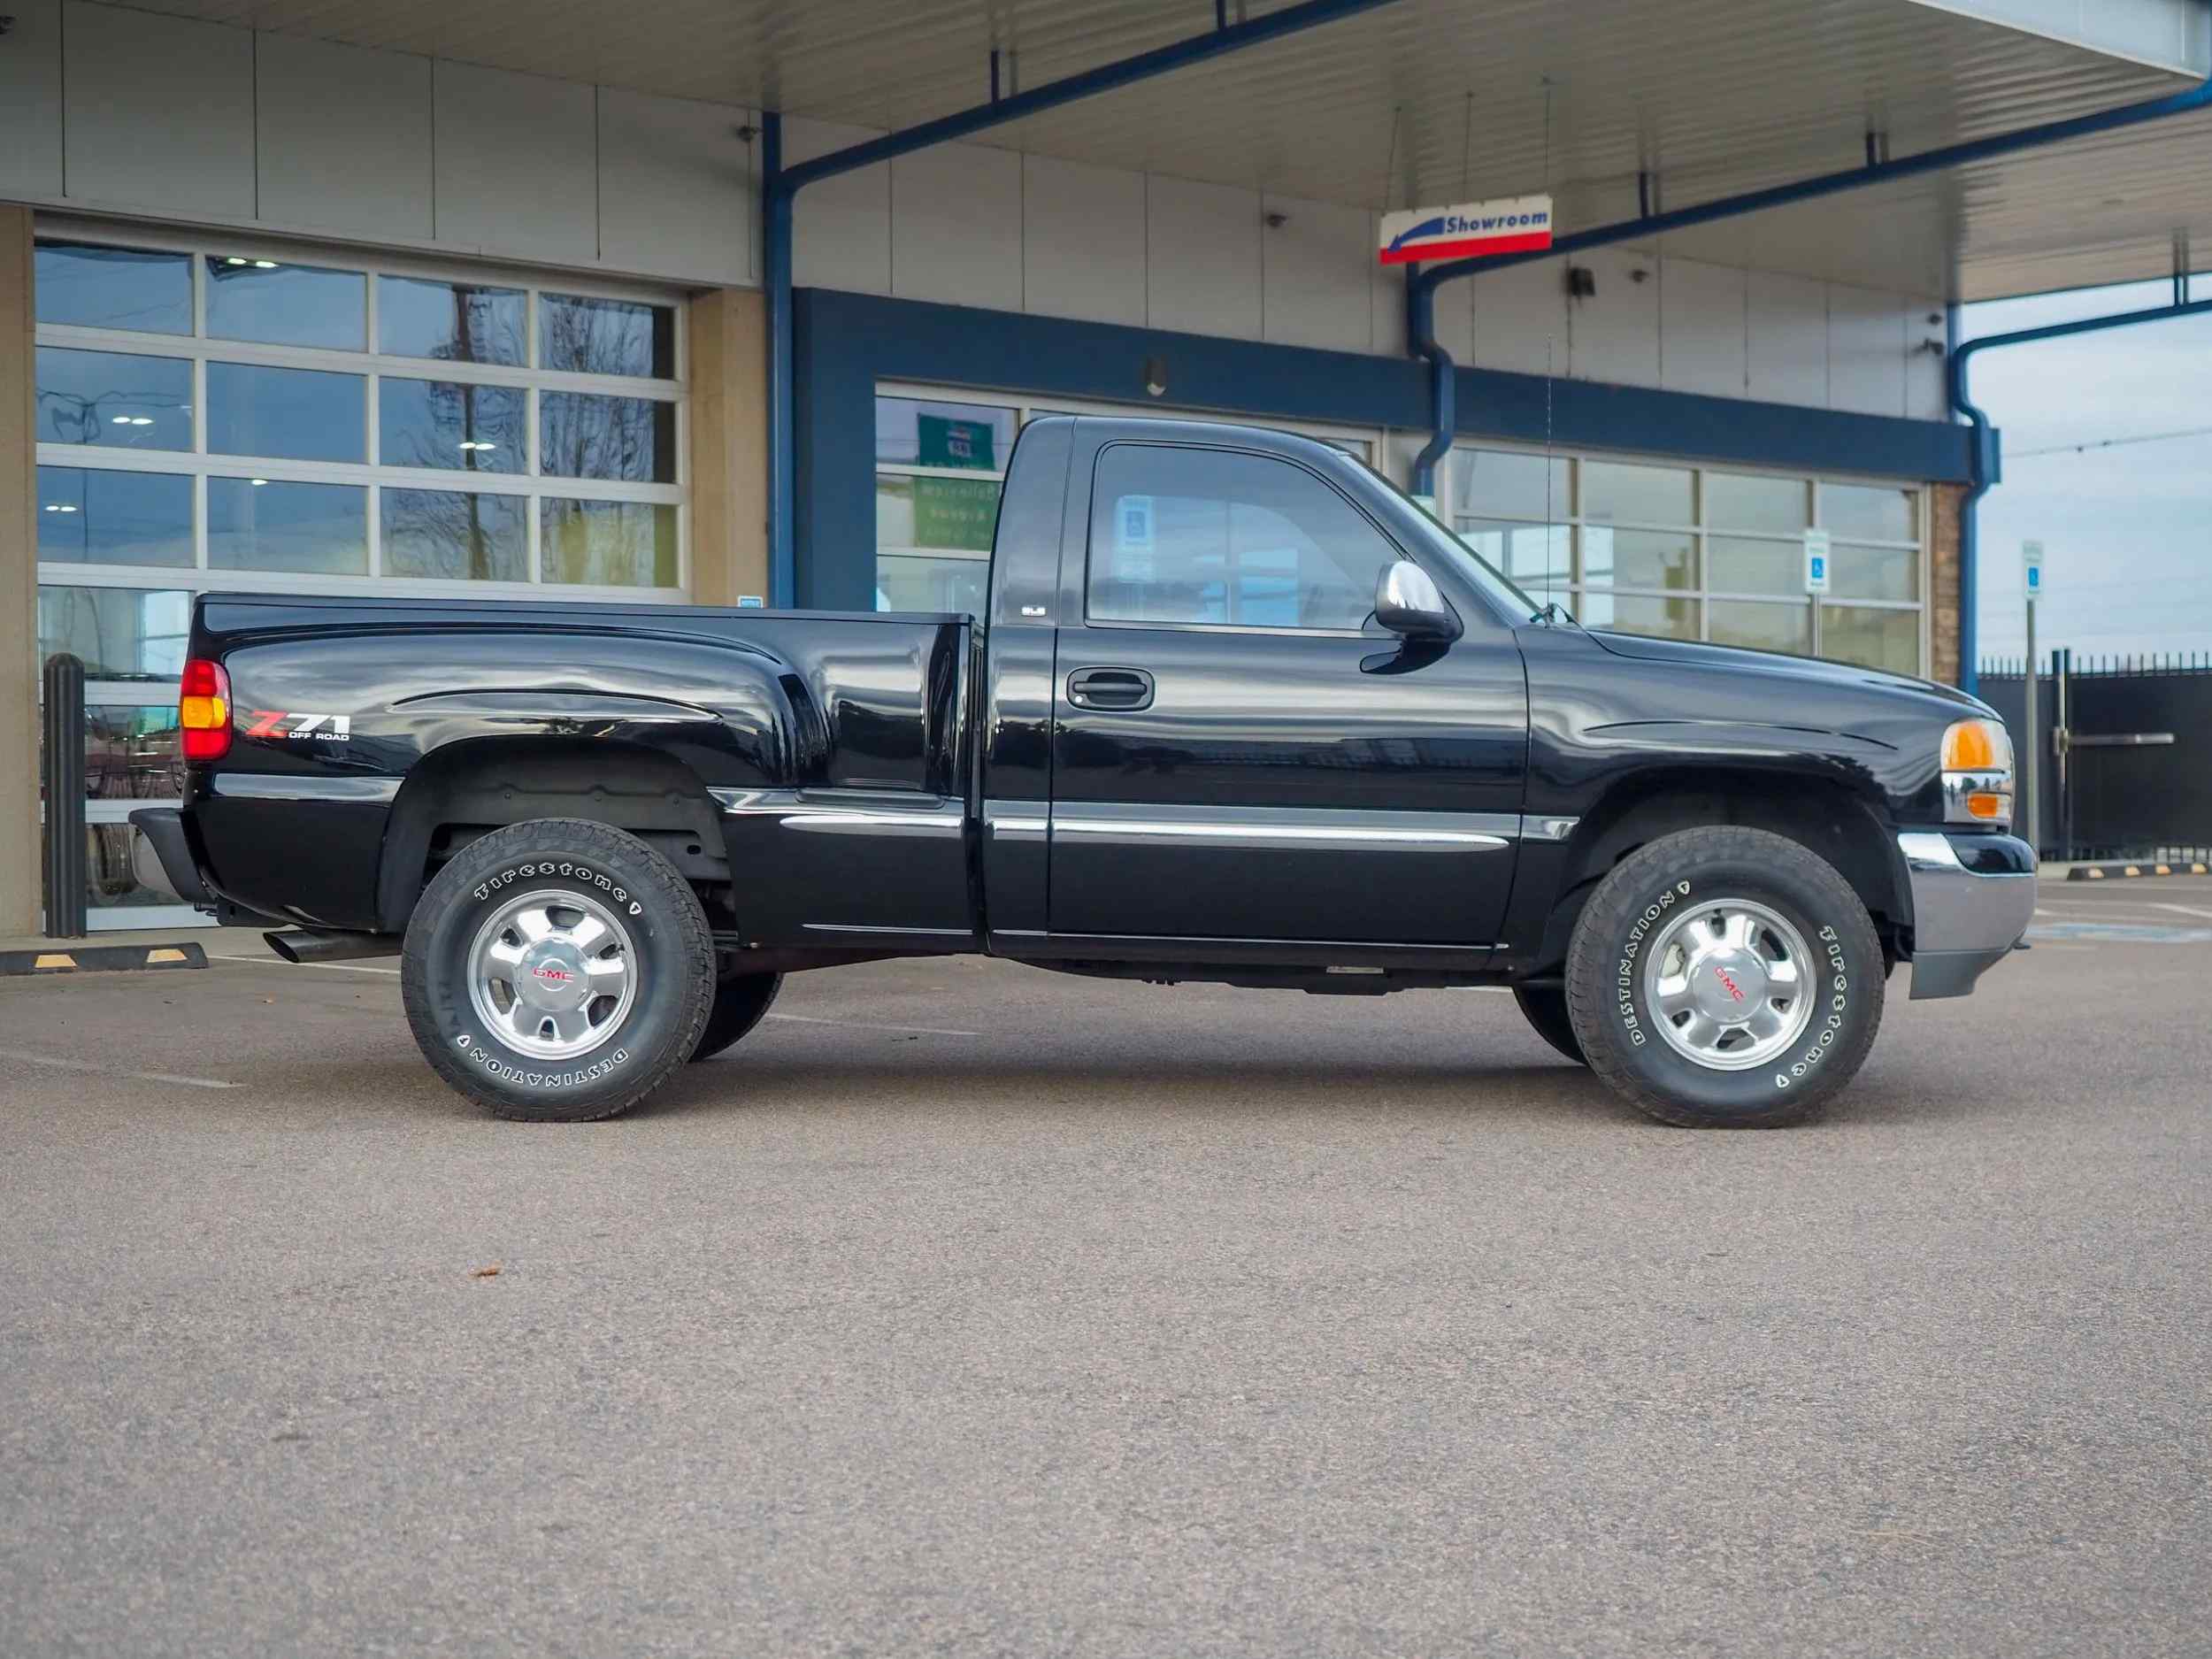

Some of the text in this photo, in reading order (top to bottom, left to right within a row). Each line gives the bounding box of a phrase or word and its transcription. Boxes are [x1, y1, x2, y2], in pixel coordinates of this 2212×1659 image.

[1447, 211, 1548, 234] Showroom
[245, 710, 351, 739] Z71
[315, 733, 350, 741] ROAD
[473, 862, 627, 902] Firestone
[532, 967, 574, 983] GMC
[1617, 890, 1676, 1046] DESTINATION
[1713, 965, 1746, 1002] GMC
[1791, 925, 1847, 1077] Firestone
[469, 1047, 629, 1087] DESTINATION
